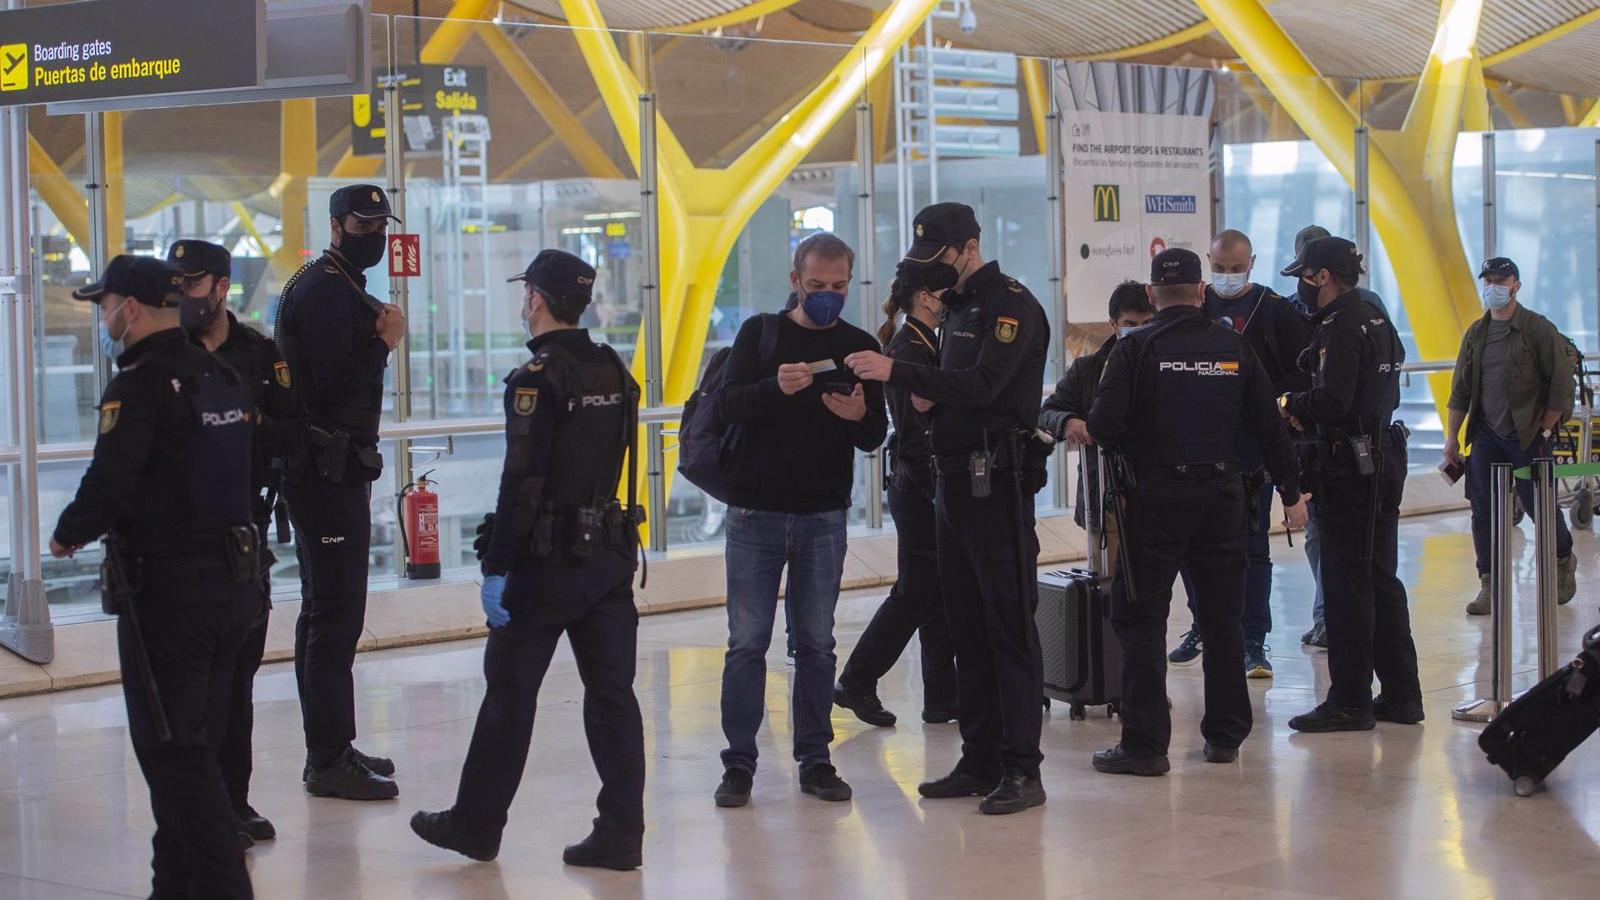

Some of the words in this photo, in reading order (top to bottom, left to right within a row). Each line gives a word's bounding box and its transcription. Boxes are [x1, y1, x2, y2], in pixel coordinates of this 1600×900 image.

[34, 41, 79, 62] Boarding
[82, 39, 112, 60] gates
[35, 66, 86, 86] Puertas
[89, 61, 106, 81] de
[110, 58, 181, 80] embarque
[443, 67, 467, 87] Exit
[435, 90, 477, 111] Salida
[1072, 143, 1089, 153] FIND
[1090, 144, 1102, 153] THE
[1104, 145, 1132, 154] AIRPORT
[1133, 145, 1153, 155] SHOPS
[1161, 146, 1203, 157] RESTAURANTS
[1146, 196, 1195, 211] WHSmith
[1159, 361, 1222, 371] POLICIA
[202, 408, 244, 425] POLICIA
[321, 536, 345, 544] CNP
